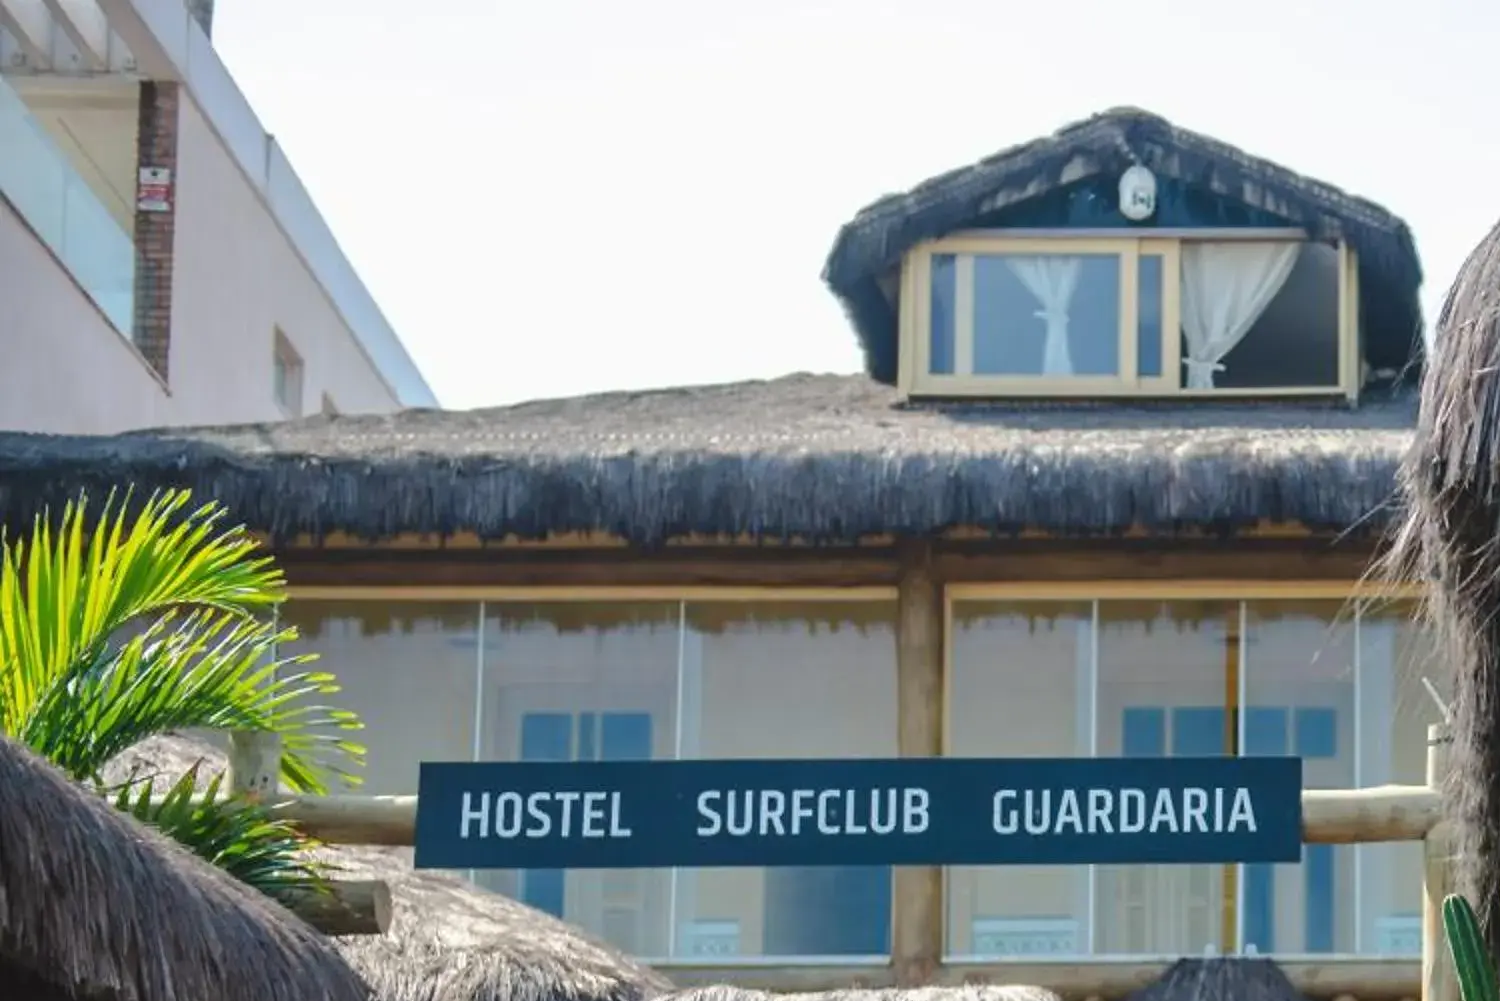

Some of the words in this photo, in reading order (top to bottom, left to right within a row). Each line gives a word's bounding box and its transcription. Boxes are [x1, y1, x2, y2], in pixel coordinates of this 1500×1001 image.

[460, 791, 632, 838] HOSTEL
[697, 788, 929, 836] SURFCLUB
[993, 787, 1257, 835] GUARDARIA
